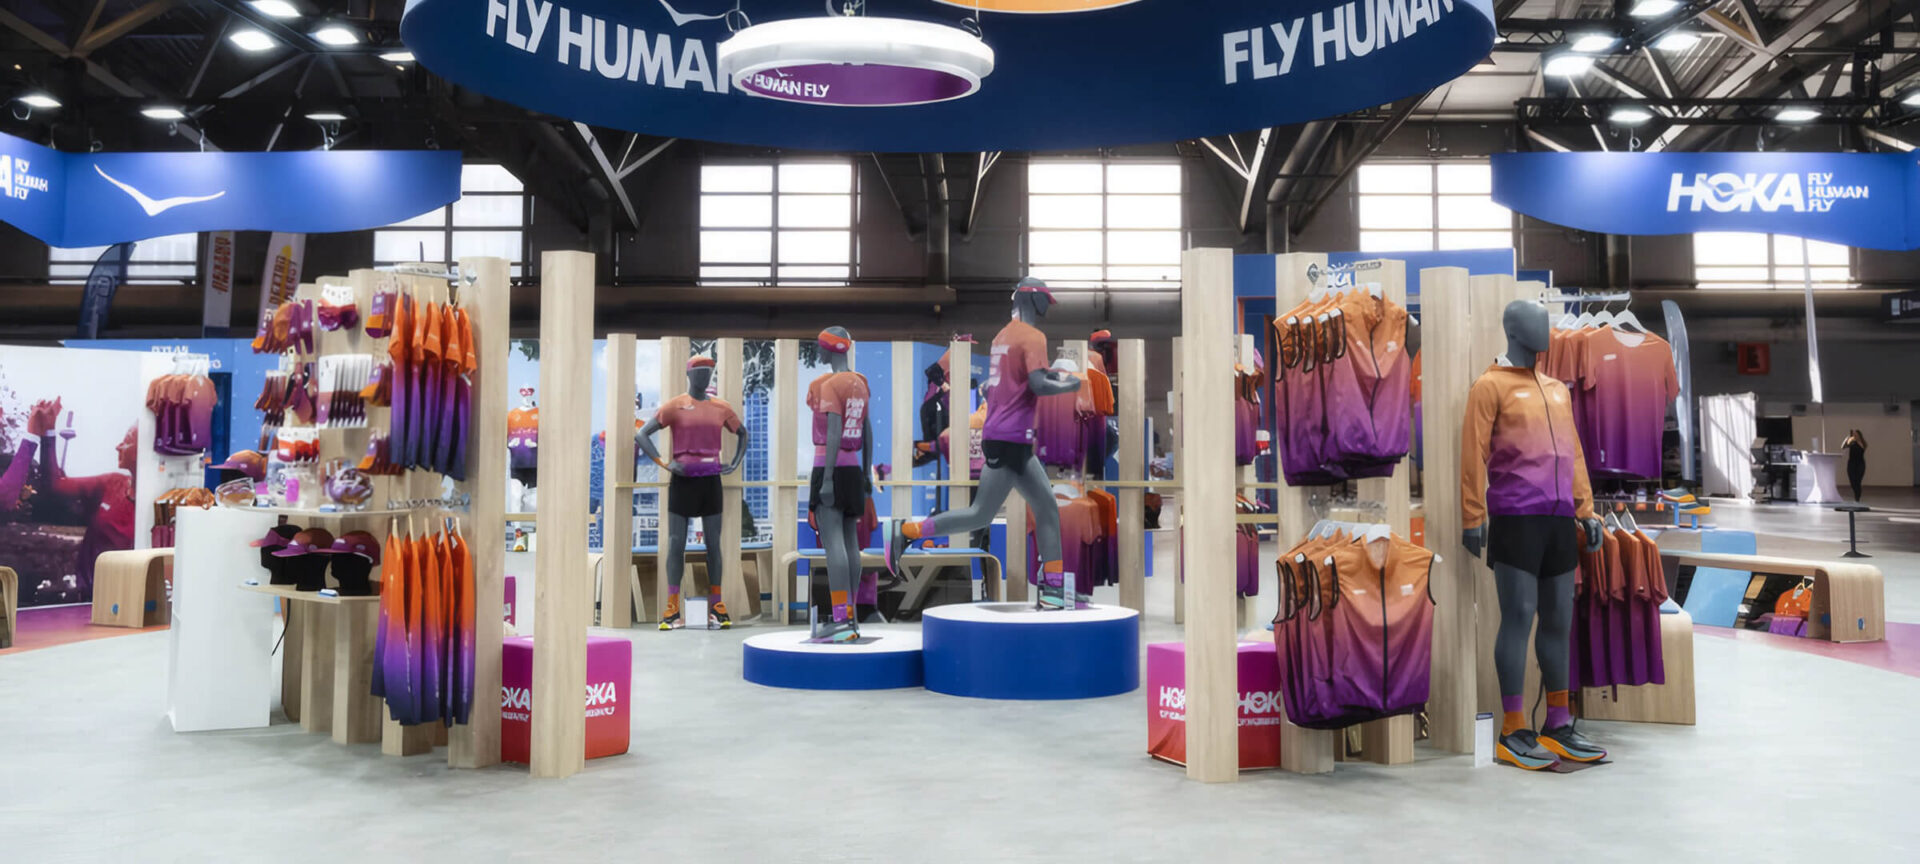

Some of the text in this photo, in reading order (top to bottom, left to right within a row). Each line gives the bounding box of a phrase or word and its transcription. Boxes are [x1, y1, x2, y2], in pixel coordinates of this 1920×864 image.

[486, 0, 553, 54] FLY
[1223, 17, 1305, 84] FLY
[804, 82, 830, 97] FLY
[1667, 172, 1806, 213] HOKA
[1807, 172, 1834, 186] FLY
[1807, 199, 1836, 212] FLY
